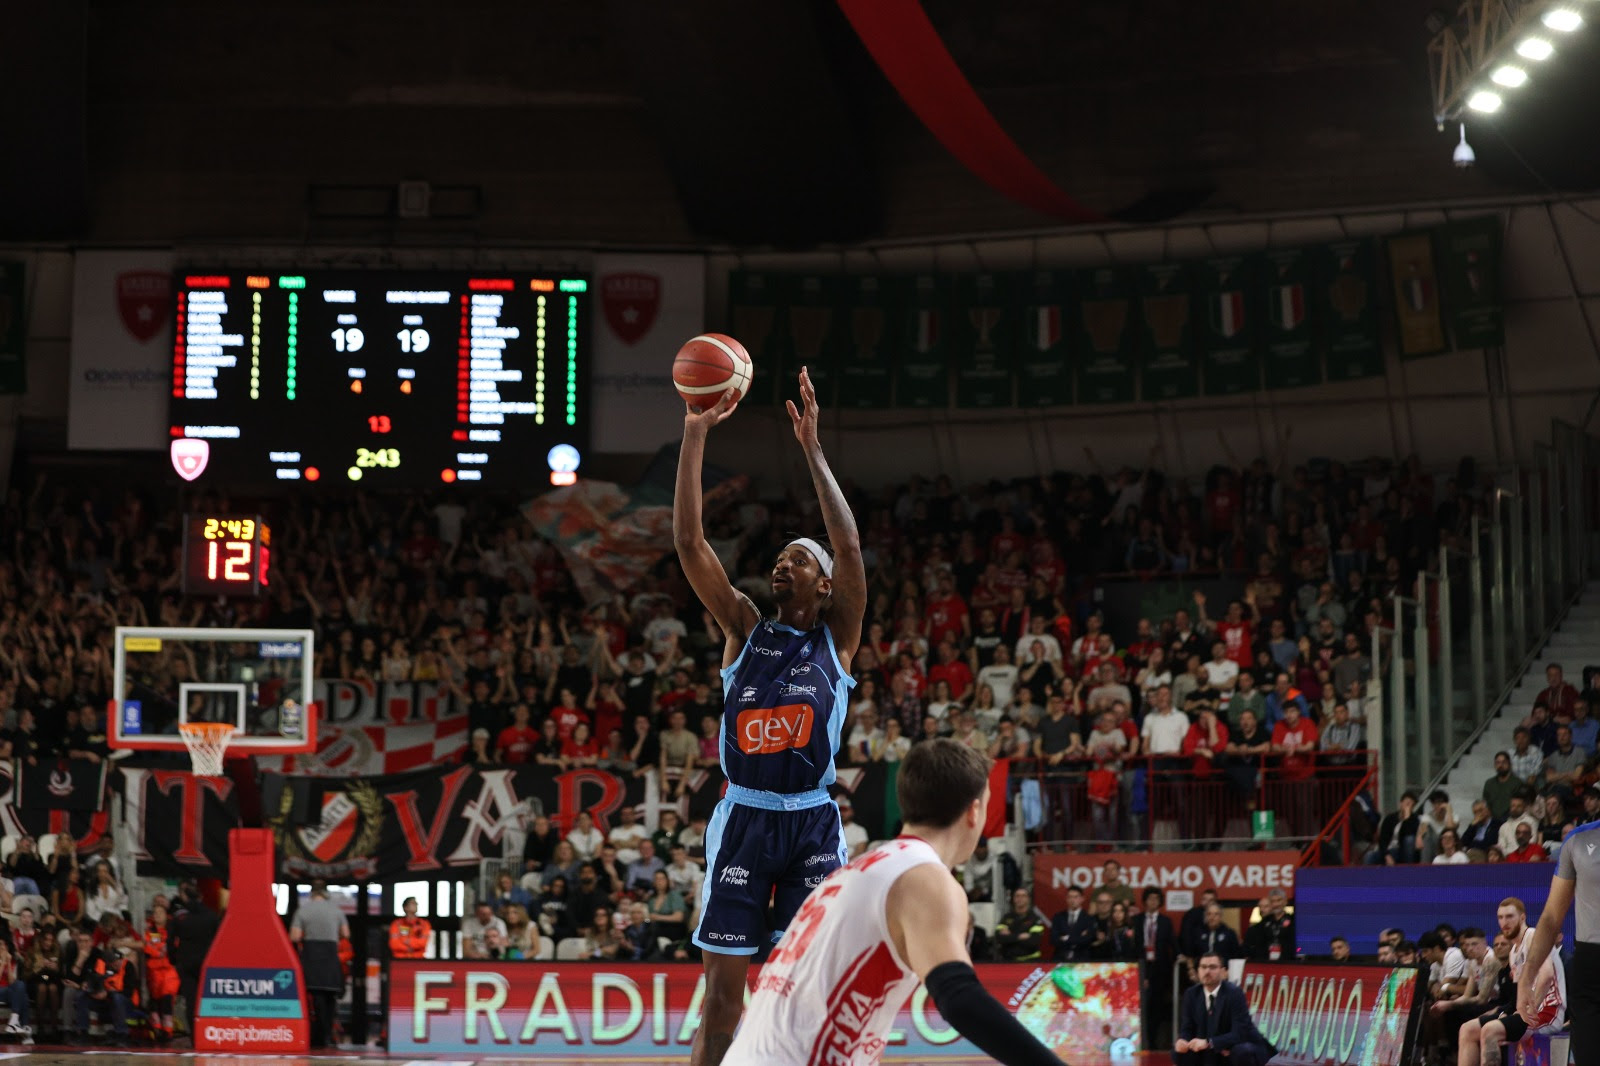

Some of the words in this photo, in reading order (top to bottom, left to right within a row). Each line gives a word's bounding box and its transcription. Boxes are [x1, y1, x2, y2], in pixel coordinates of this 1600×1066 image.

[331, 328, 364, 352] 19
[397, 328, 430, 353] 19
[368, 415, 391, 433] 13
[356, 447, 400, 468] 2:43
[204, 518, 255, 539] 2:43
[208, 541, 251, 580] 12
[745, 706, 807, 752] gevi
[1052, 866, 1105, 888] NOI
[210, 978, 274, 995] ITELYUM
[205, 1025, 294, 1046] Openjobmetis
